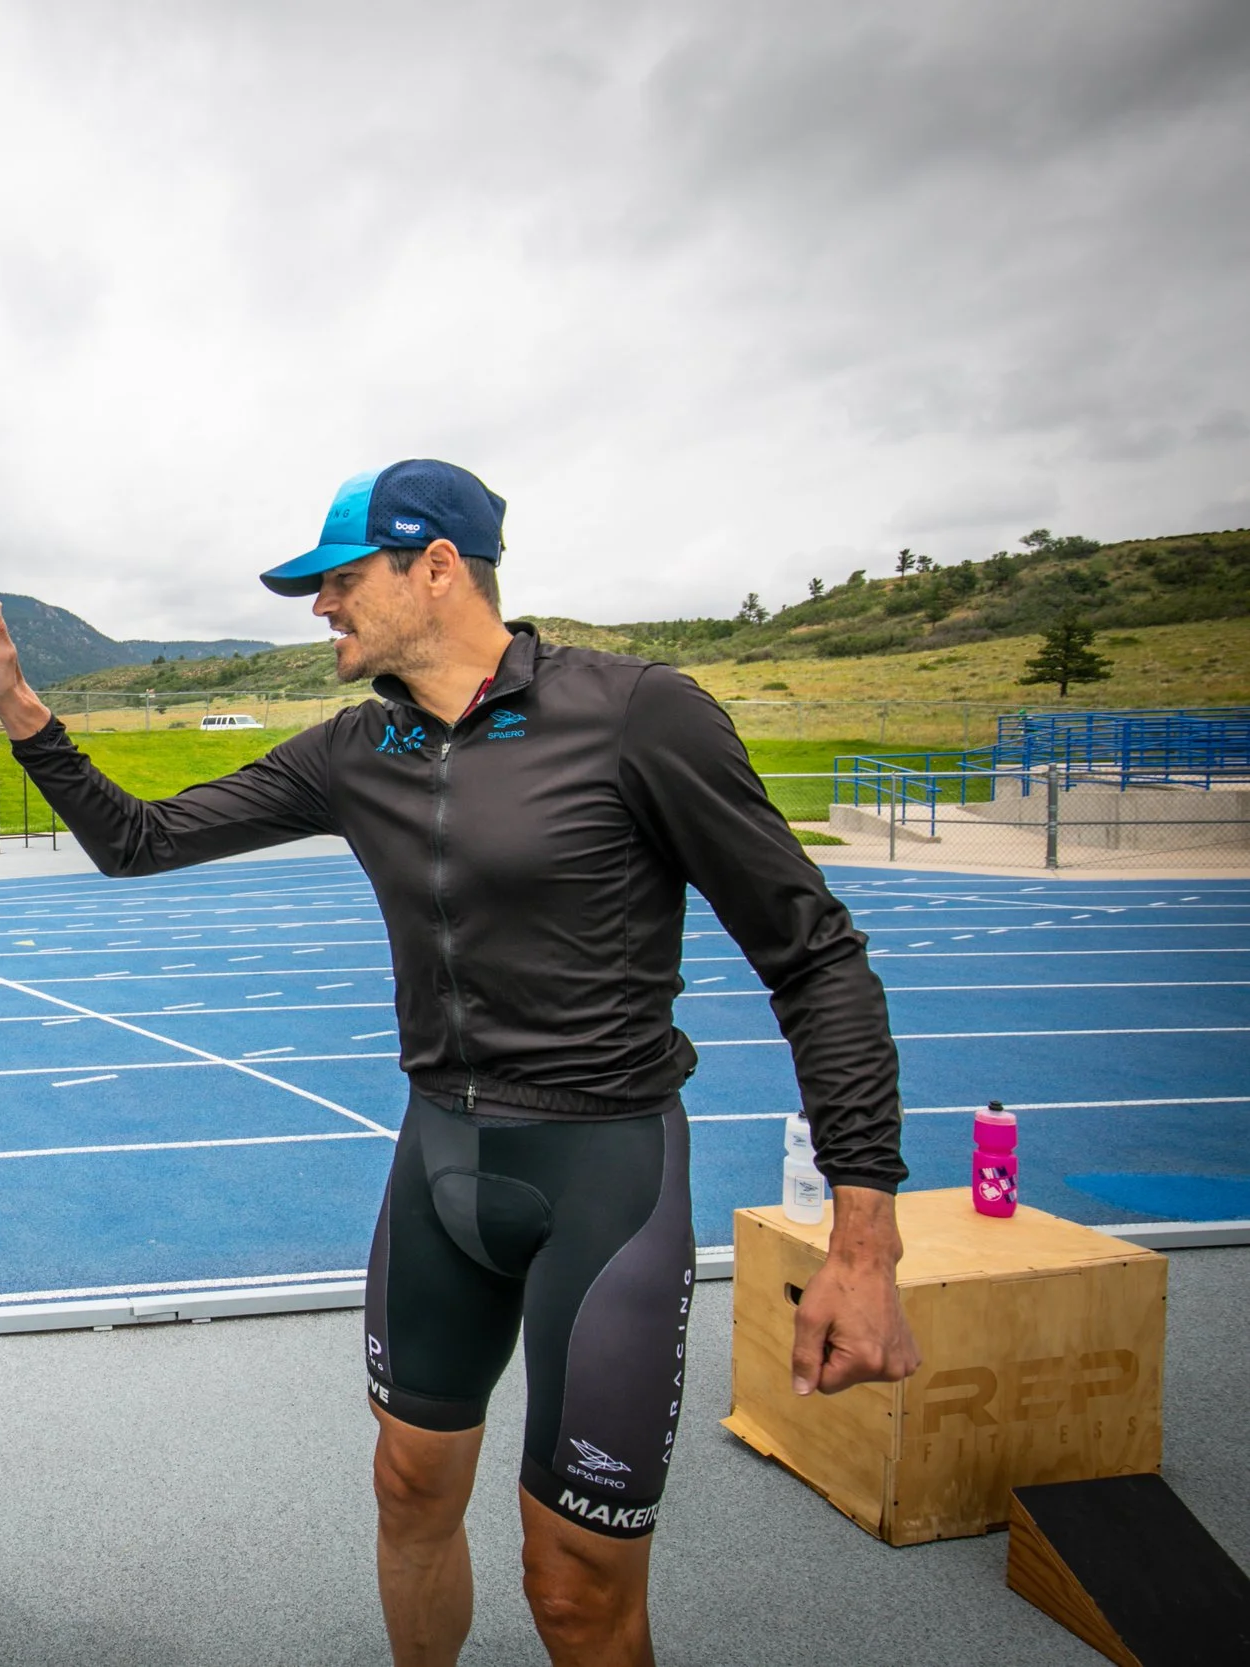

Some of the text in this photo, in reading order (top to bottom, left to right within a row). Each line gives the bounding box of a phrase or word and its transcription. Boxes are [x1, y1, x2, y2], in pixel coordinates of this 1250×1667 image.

[486, 729, 526, 740] SPAERO
[922, 1348, 1141, 1435] REP
[566, 1464, 626, 1490] SPAERO
